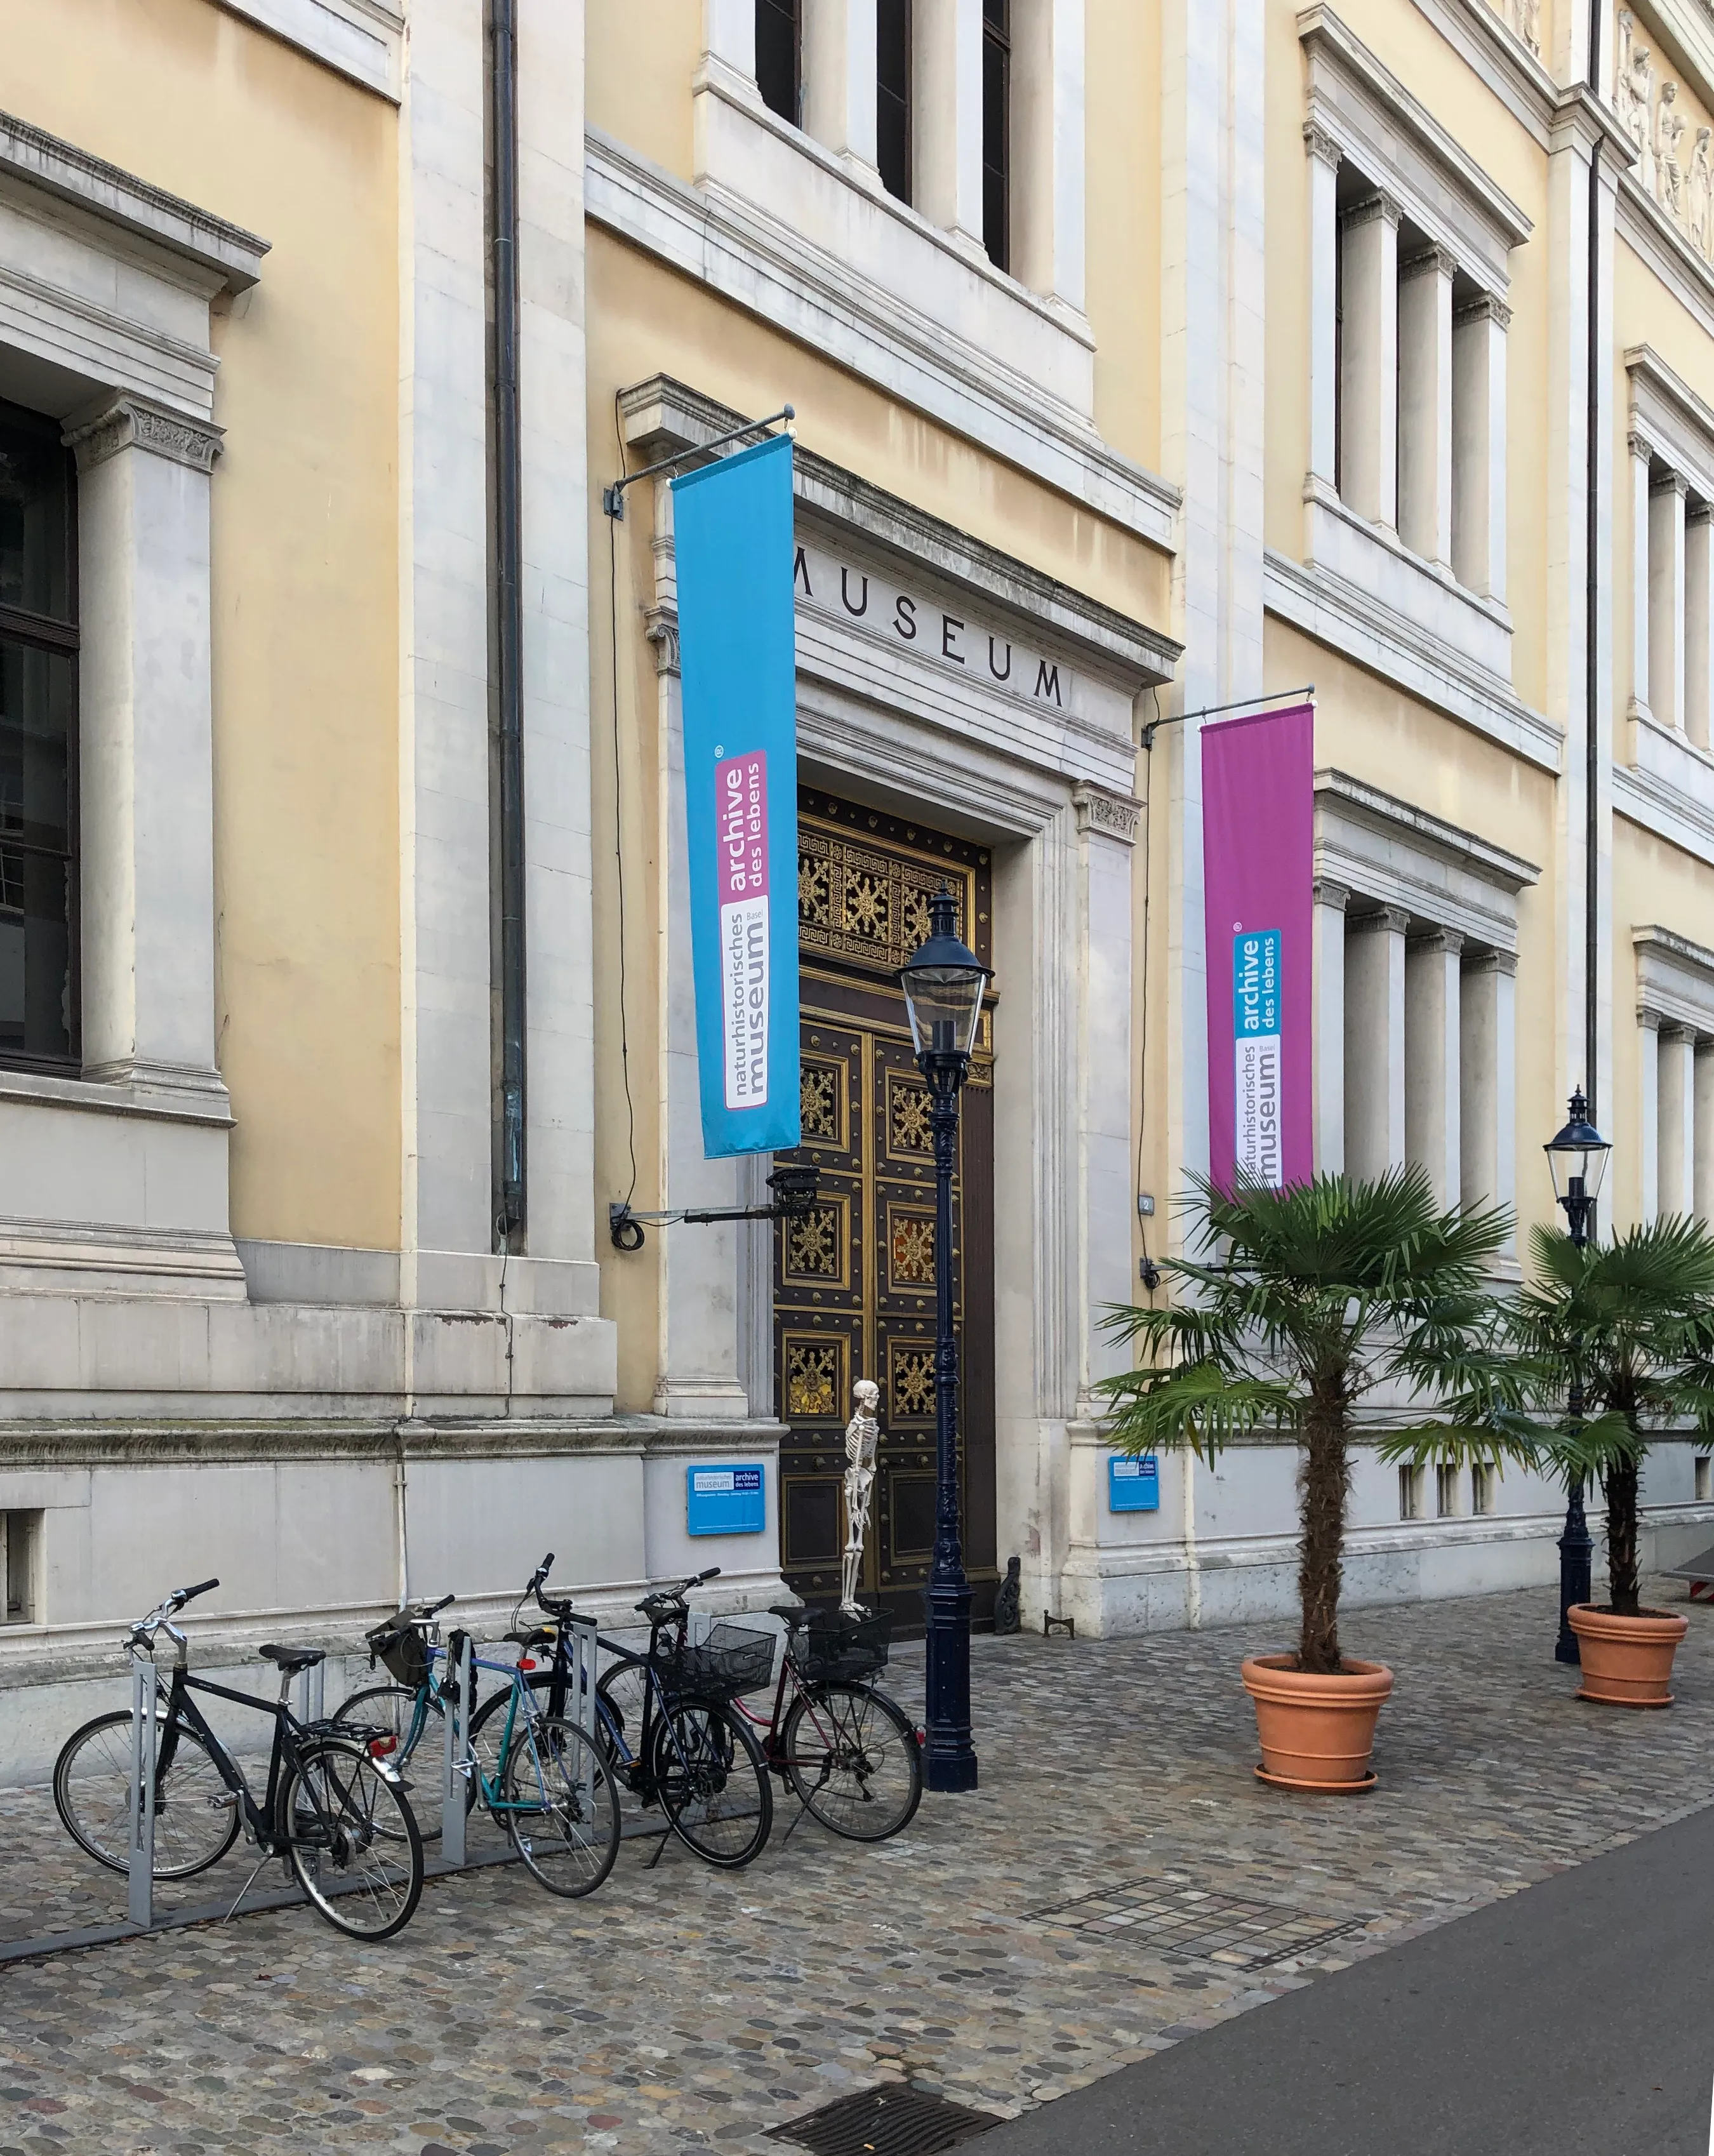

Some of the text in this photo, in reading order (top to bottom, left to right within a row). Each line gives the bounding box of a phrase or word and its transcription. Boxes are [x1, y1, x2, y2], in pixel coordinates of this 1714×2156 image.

[722, 768, 746, 891] archive
[747, 762, 762, 888] des lebens
[747, 909, 763, 921] Basel
[729, 913, 747, 1096] naturhistorisches
[747, 921, 764, 1094] museum
[1238, 940, 1260, 1030] archive
[1261, 937, 1275, 1028] des lebens
[1259, 1053, 1277, 1179] museum
[1144, 1199, 1149, 1210] 2
[696, 1481, 729, 1489] museum
[735, 1472, 759, 1481] archive
